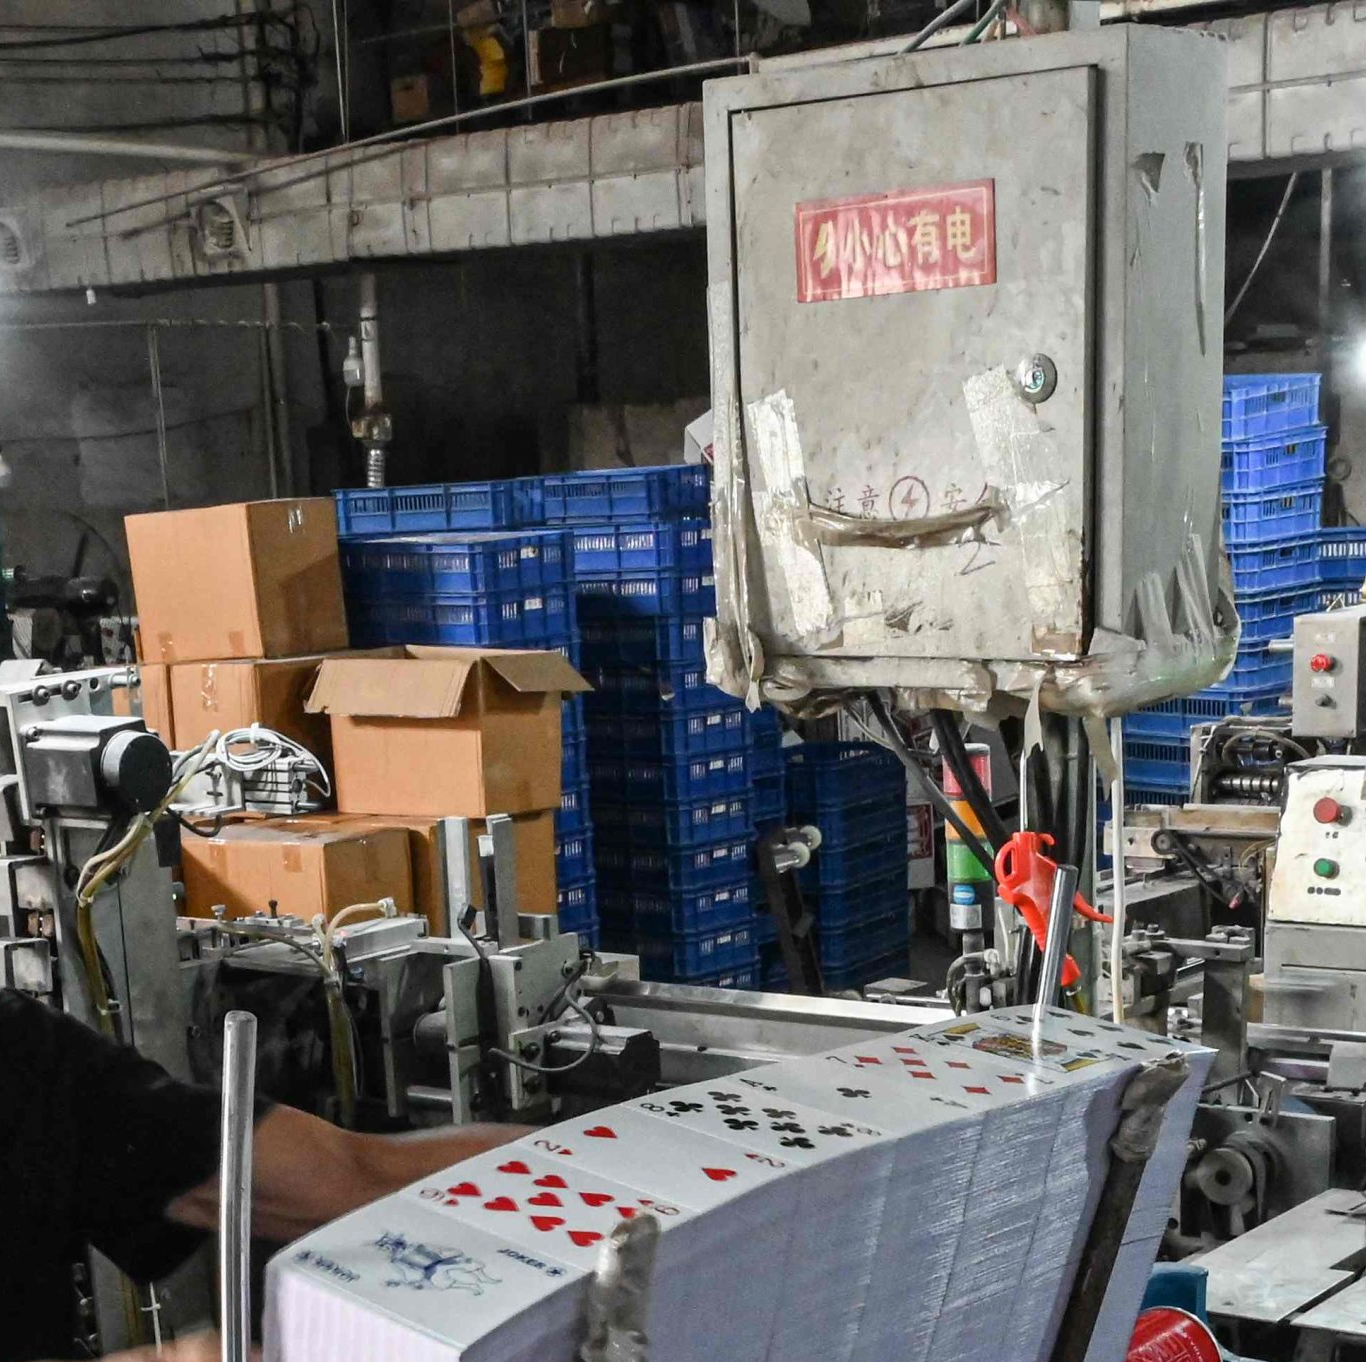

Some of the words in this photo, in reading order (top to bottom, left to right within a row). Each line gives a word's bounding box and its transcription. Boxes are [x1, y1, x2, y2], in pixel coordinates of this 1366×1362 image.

[843, 204, 982, 274] 小心有电
[640, 1102, 666, 1113] 8
[534, 1139, 562, 1152] 2
[496, 1249, 547, 1270] JOKER
